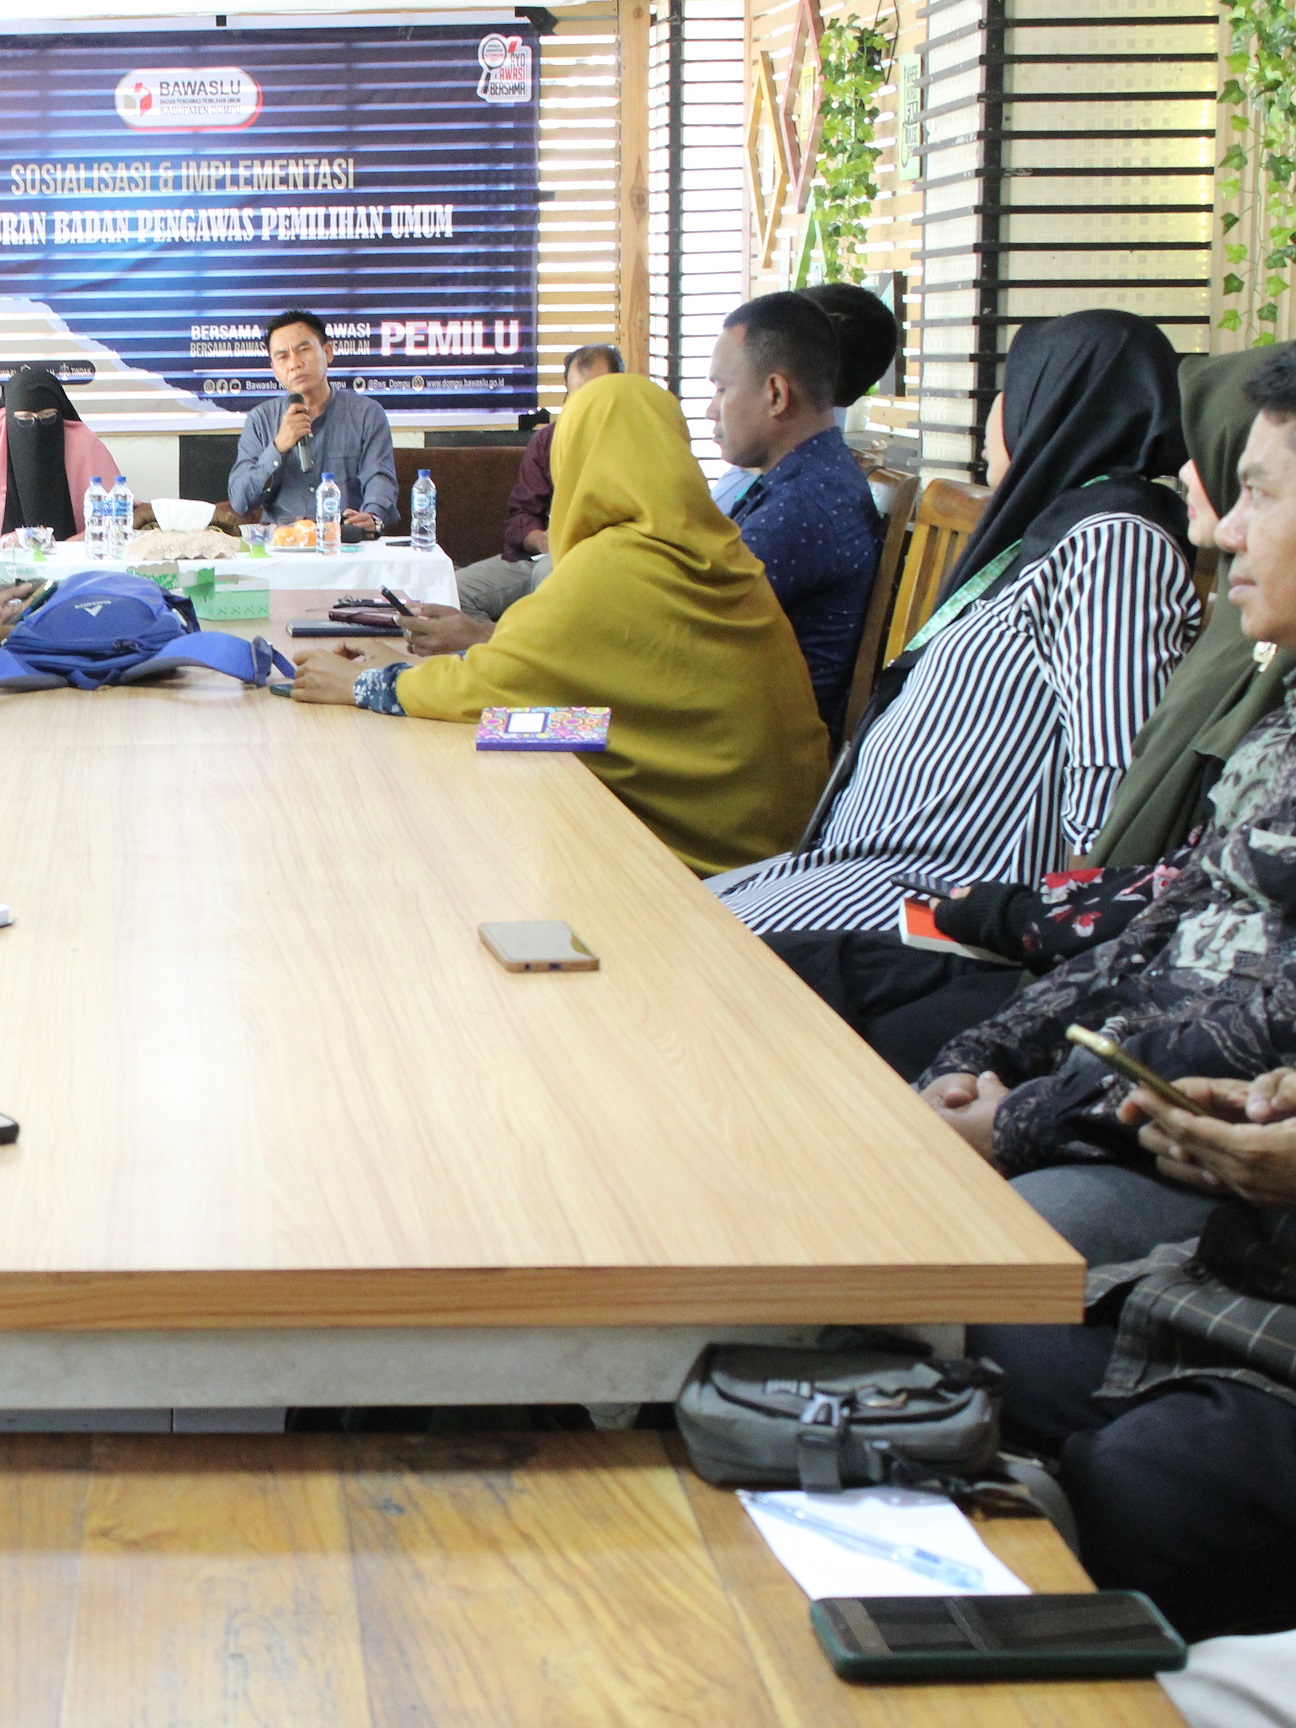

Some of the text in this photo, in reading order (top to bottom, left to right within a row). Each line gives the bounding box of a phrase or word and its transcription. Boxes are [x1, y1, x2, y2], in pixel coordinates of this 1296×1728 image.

[510, 53, 526, 66] AYO
[500, 68, 526, 81] AWASI
[159, 80, 241, 97] BAWASLU
[490, 82, 525, 95] BERSAMA
[160, 104, 241, 116] KABUPATEN DOMPU
[10, 157, 355, 196] SOSIALISASI & IMPLEMENTASI
[54, 208, 130, 245] BADAN
[136, 206, 254, 244] PENGAWAS
[260, 203, 383, 242] PEMILIHAN
[389, 203, 454, 240] UMUM
[190, 319, 521, 357] BERSAMA AWASI PEMILU
[189, 341, 233, 358] BERSAMA
[245, 380, 277, 391] Bawaslu
[425, 377, 505, 390] www.dompu.bawaslu.go.id
